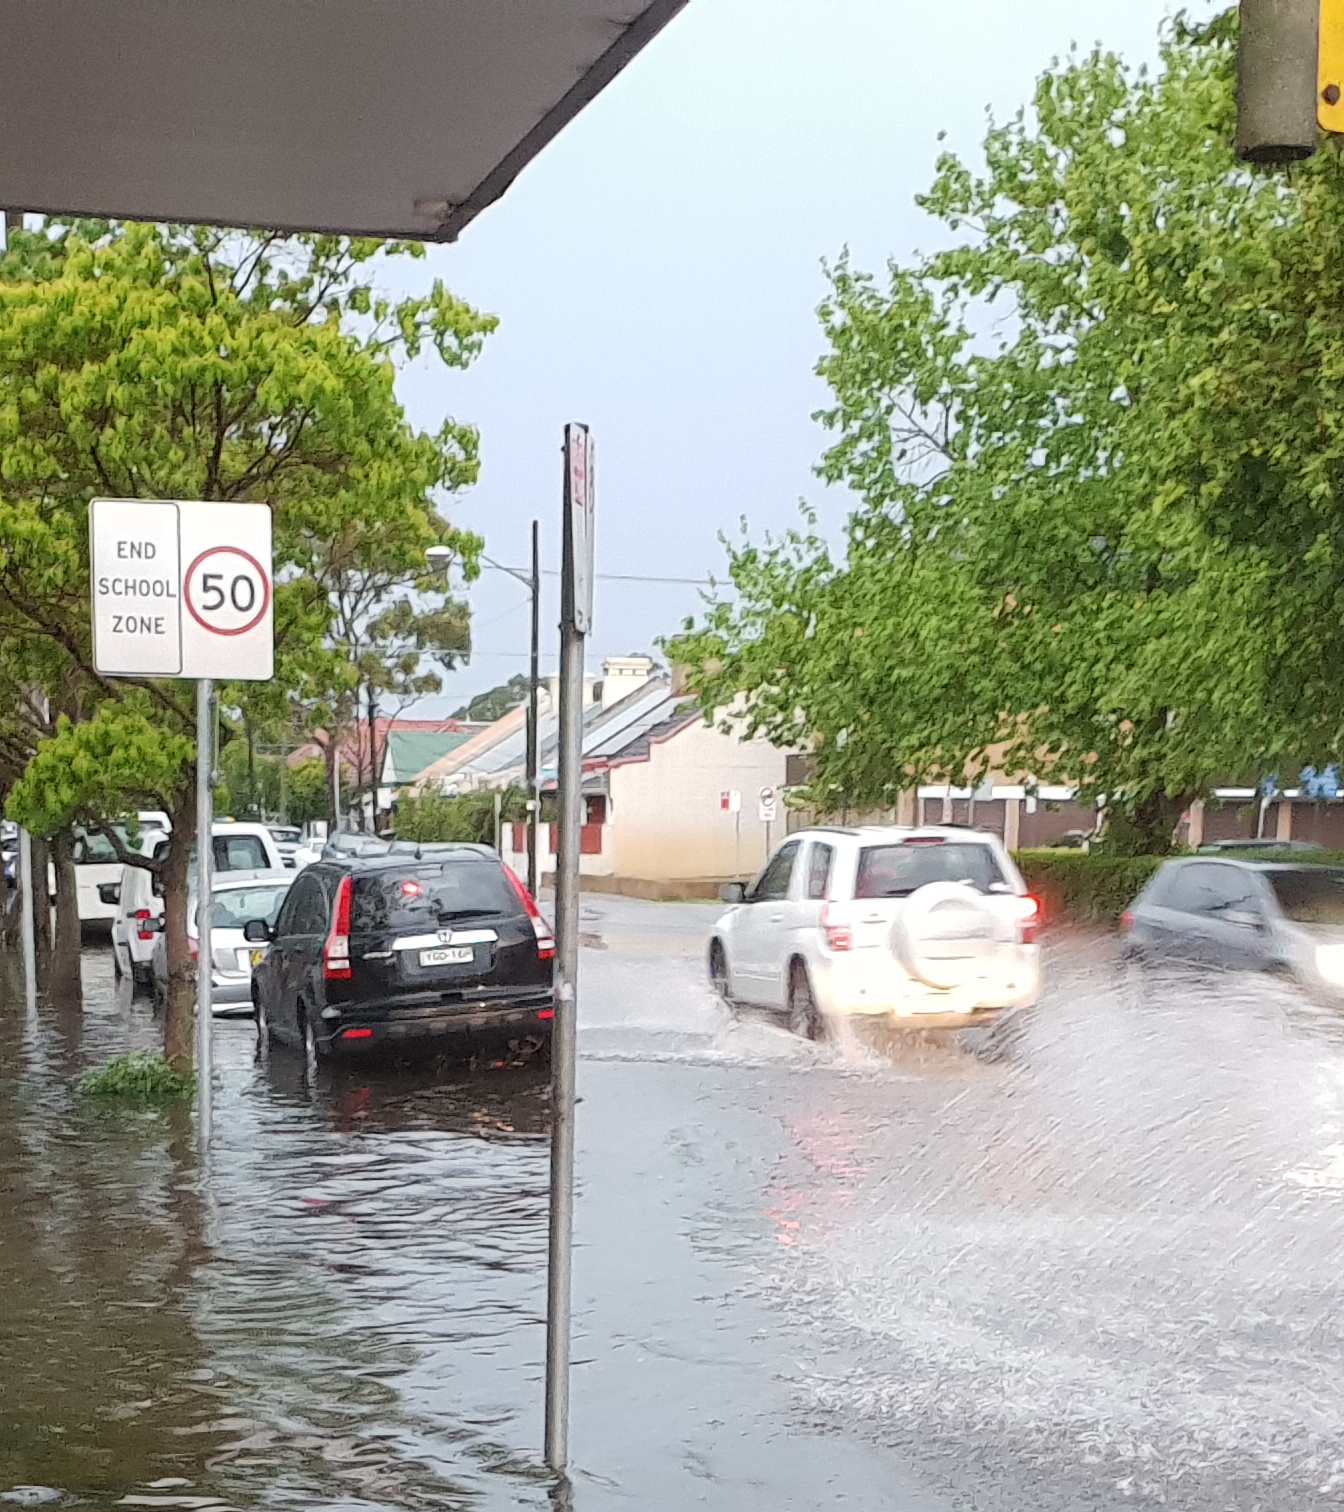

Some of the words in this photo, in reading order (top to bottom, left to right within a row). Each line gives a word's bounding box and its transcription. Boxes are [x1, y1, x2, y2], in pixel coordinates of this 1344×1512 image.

[117, 541, 156, 560] END
[98, 578, 177, 598] SCHOOL
[202, 573, 255, 612] 50
[112, 615, 166, 634] ZONE
